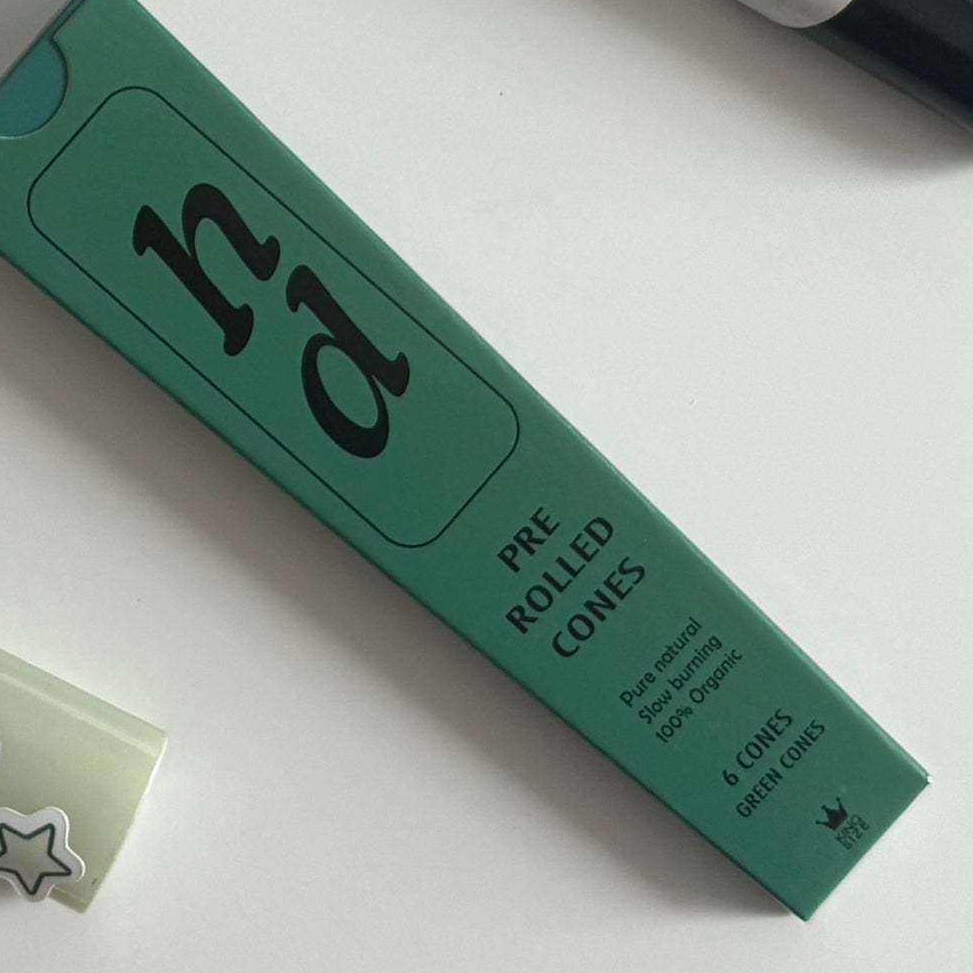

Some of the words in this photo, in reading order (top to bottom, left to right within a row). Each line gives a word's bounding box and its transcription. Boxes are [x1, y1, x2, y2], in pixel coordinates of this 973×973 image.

[132, 182, 281, 357] h
[285, 264, 411, 459] d
[496, 506, 561, 574] PRE
[504, 516, 614, 635] ROLLED
[551, 556, 646, 658] CONES
[619, 671, 656, 708] Pure
[653, 615, 703, 673] natural
[638, 689, 673, 725] Slow
[666, 634, 723, 691] burning
[655, 705, 694, 743] 100%
[688, 648, 743, 705] Organic
[722, 769, 740, 787] 6
[735, 707, 794, 770] CONES
[735, 767, 783, 818] GREEN
[779, 719, 826, 769] CONES
